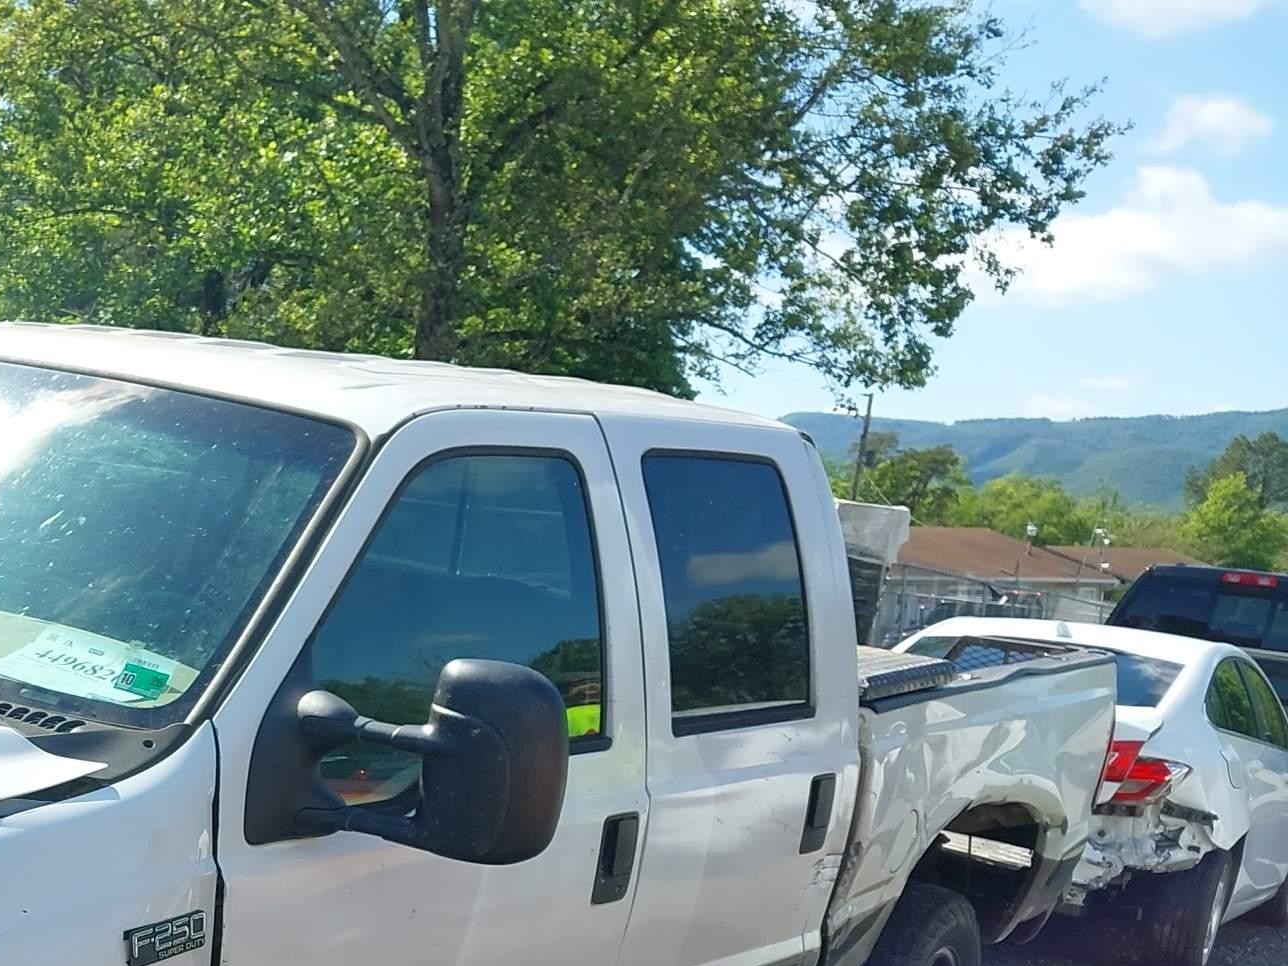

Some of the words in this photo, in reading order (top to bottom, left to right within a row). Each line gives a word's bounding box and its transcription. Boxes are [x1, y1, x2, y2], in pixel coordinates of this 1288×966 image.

[34, 649, 122, 683] 449682
[120, 673, 136, 686] 10
[158, 945, 184, 960] SUPER
[185, 939, 205, 950] DUTY
